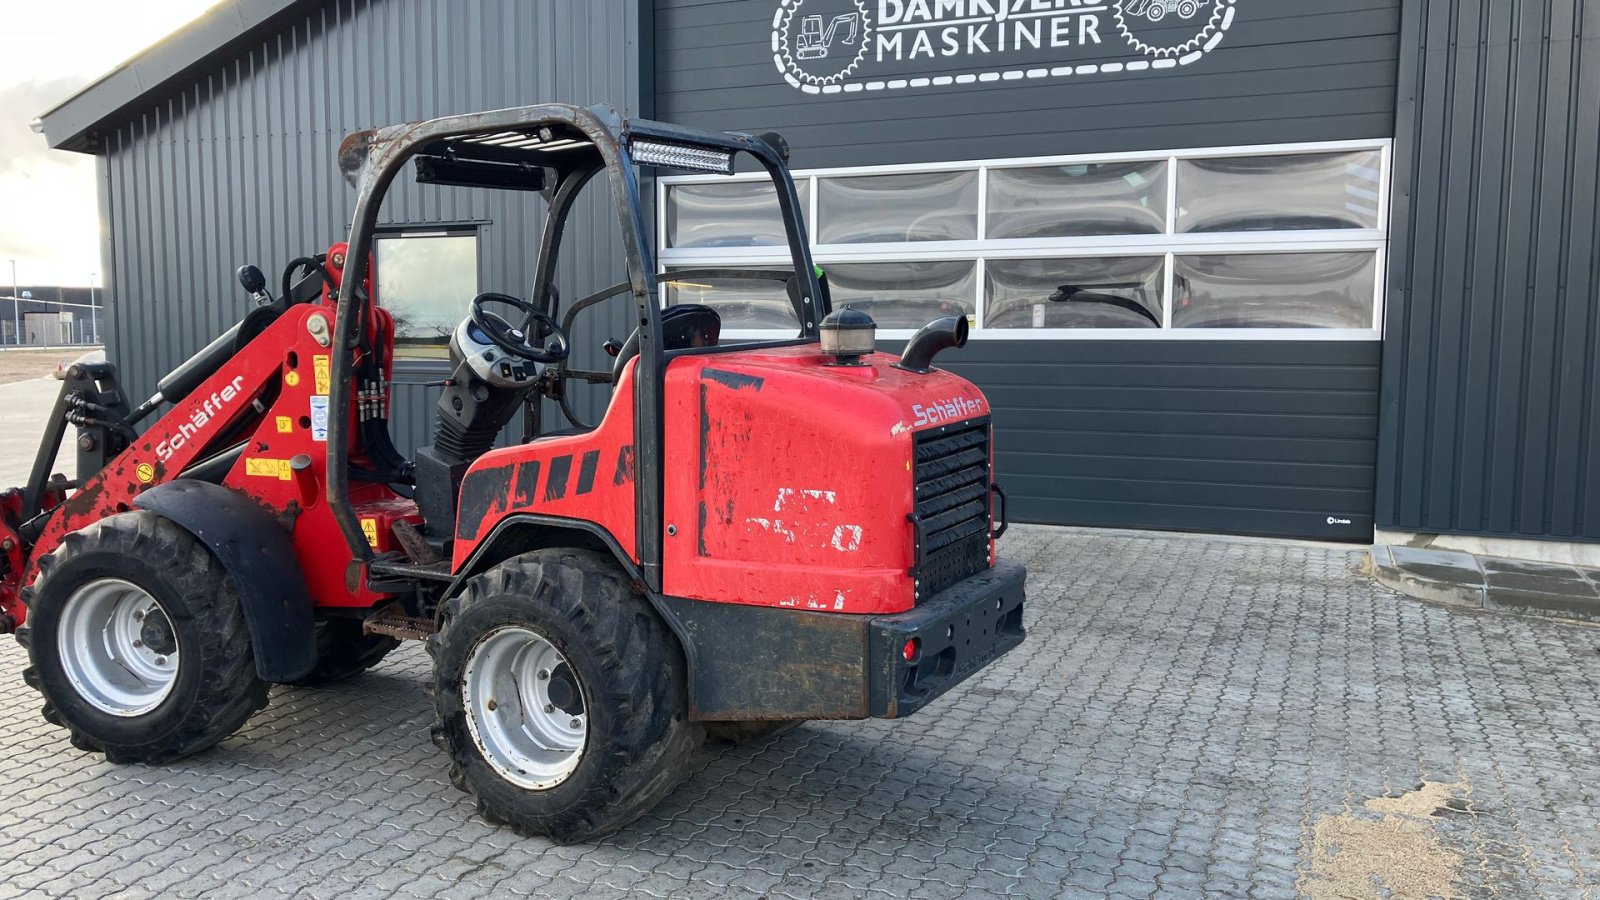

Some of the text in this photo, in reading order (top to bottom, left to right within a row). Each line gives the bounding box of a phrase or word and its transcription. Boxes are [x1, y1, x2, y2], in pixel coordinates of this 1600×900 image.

[877, 0, 1101, 25] DAMKJ
[876, 14, 1102, 62] MASKINER
[155, 375, 244, 464] Schäffer
[912, 396, 982, 427] Schäffer
